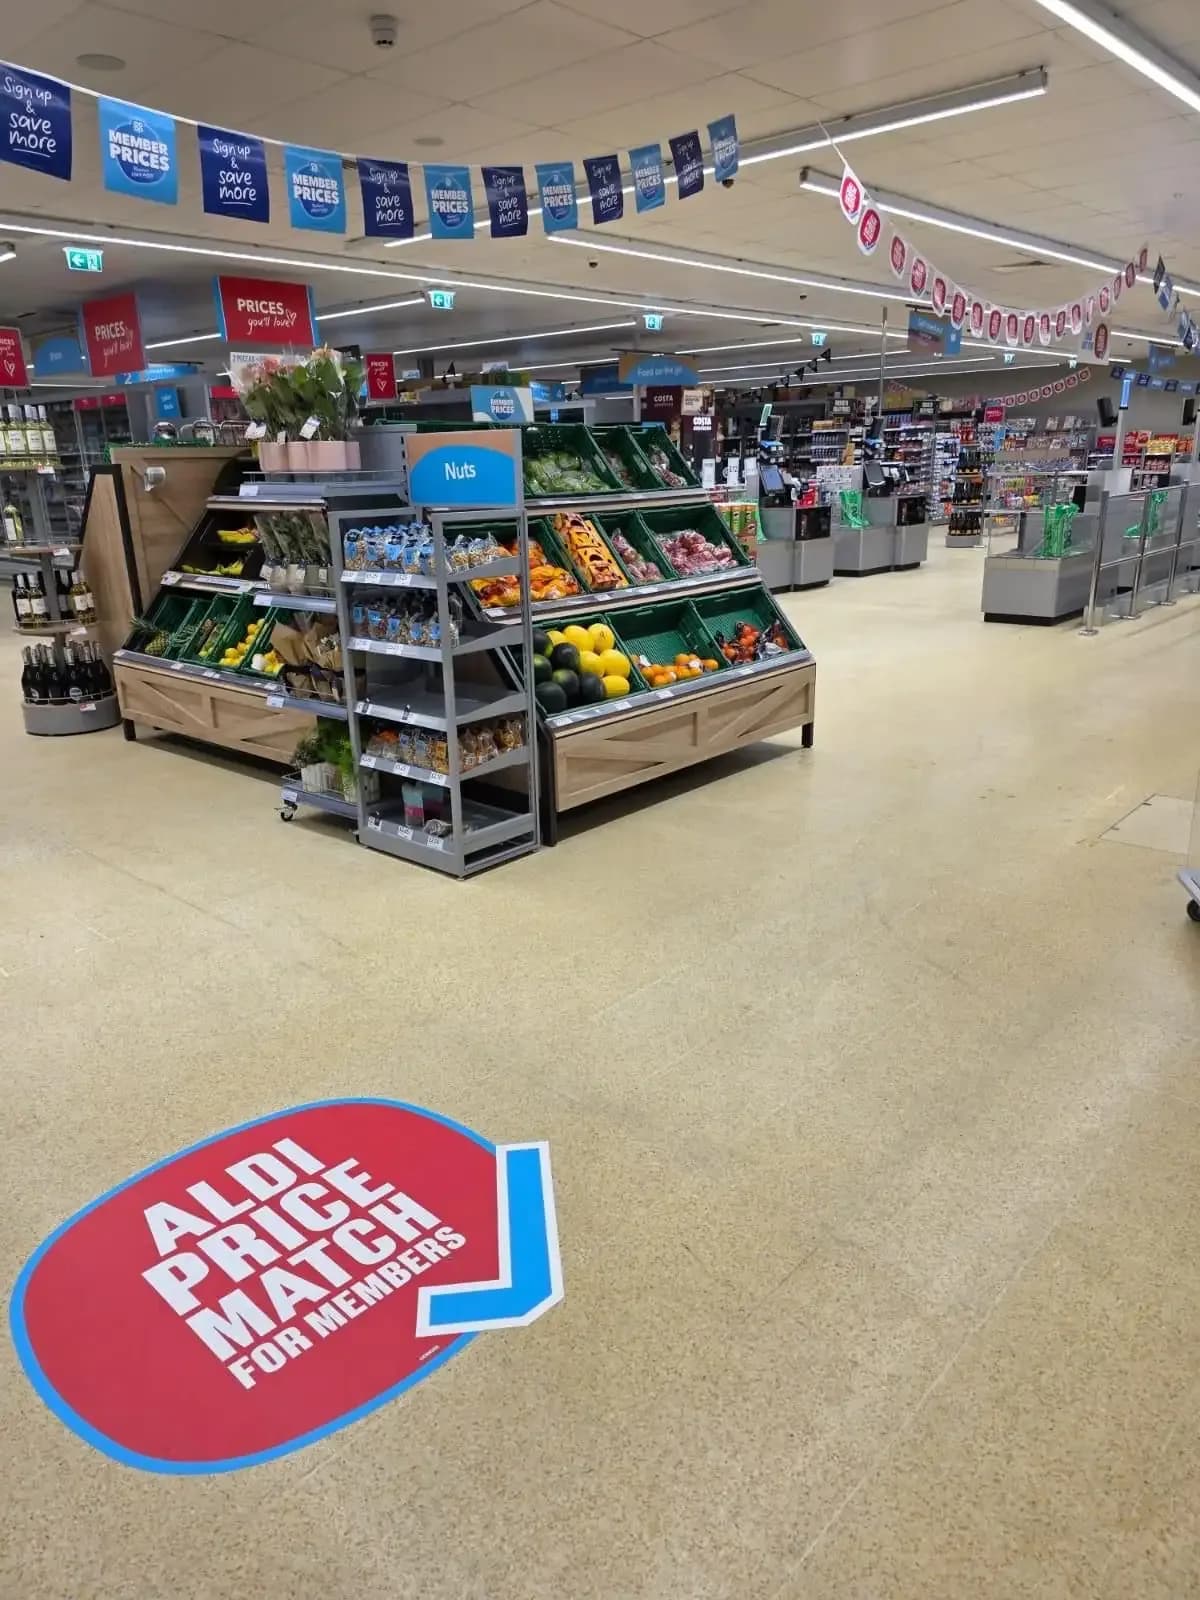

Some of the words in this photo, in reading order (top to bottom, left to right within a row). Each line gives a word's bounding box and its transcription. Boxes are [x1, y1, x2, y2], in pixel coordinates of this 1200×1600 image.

[3, 76, 33, 100] Sign
[36, 88, 52, 106] up
[25, 99, 36, 115] &
[9, 112, 52, 135] save
[9, 130, 57, 153] more
[108, 129, 168, 156] MEMBER
[213, 138, 236, 158] Sign
[238, 145, 251, 160] up
[110, 142, 170, 171] PRICES
[230, 157, 240, 170] &
[218, 170, 252, 185] save
[292, 173, 338, 191] MEMBER
[369, 167, 387, 184] Sign
[388, 169, 399, 184] up
[636, 174, 662, 192] PRICES
[219, 186, 257, 201] more
[293, 185, 340, 205] PRICES
[431, 189, 468, 201] MEMBER
[542, 184, 572, 196] MEMBER
[375, 195, 401, 209] save
[431, 201, 469, 213] PRICES
[498, 197, 519, 212] save
[543, 194, 574, 208] PRICES
[599, 196, 618, 211] more
[376, 209, 405, 223] more
[499, 209, 522, 225] more
[236, 297, 285, 316] PRICES
[94, 320, 126, 342] PRICES
[248, 316, 270, 335] you'll
[273, 315, 290, 328] love
[124, 372, 133, 384] 2
[637, 367, 654, 377] Food
[653, 395, 674, 403] COSTA
[491, 406, 515, 414] PRICES
[692, 416, 712, 425] COSTA
[444, 461, 477, 481] Nuts
[143, 1137, 326, 1257] ALDI
[141, 1157, 395, 1317] PRICE
[185, 1191, 442, 1362] MATCH
[227, 1326, 314, 1390] FOR
[303, 1226, 466, 1339] MEMBERS
